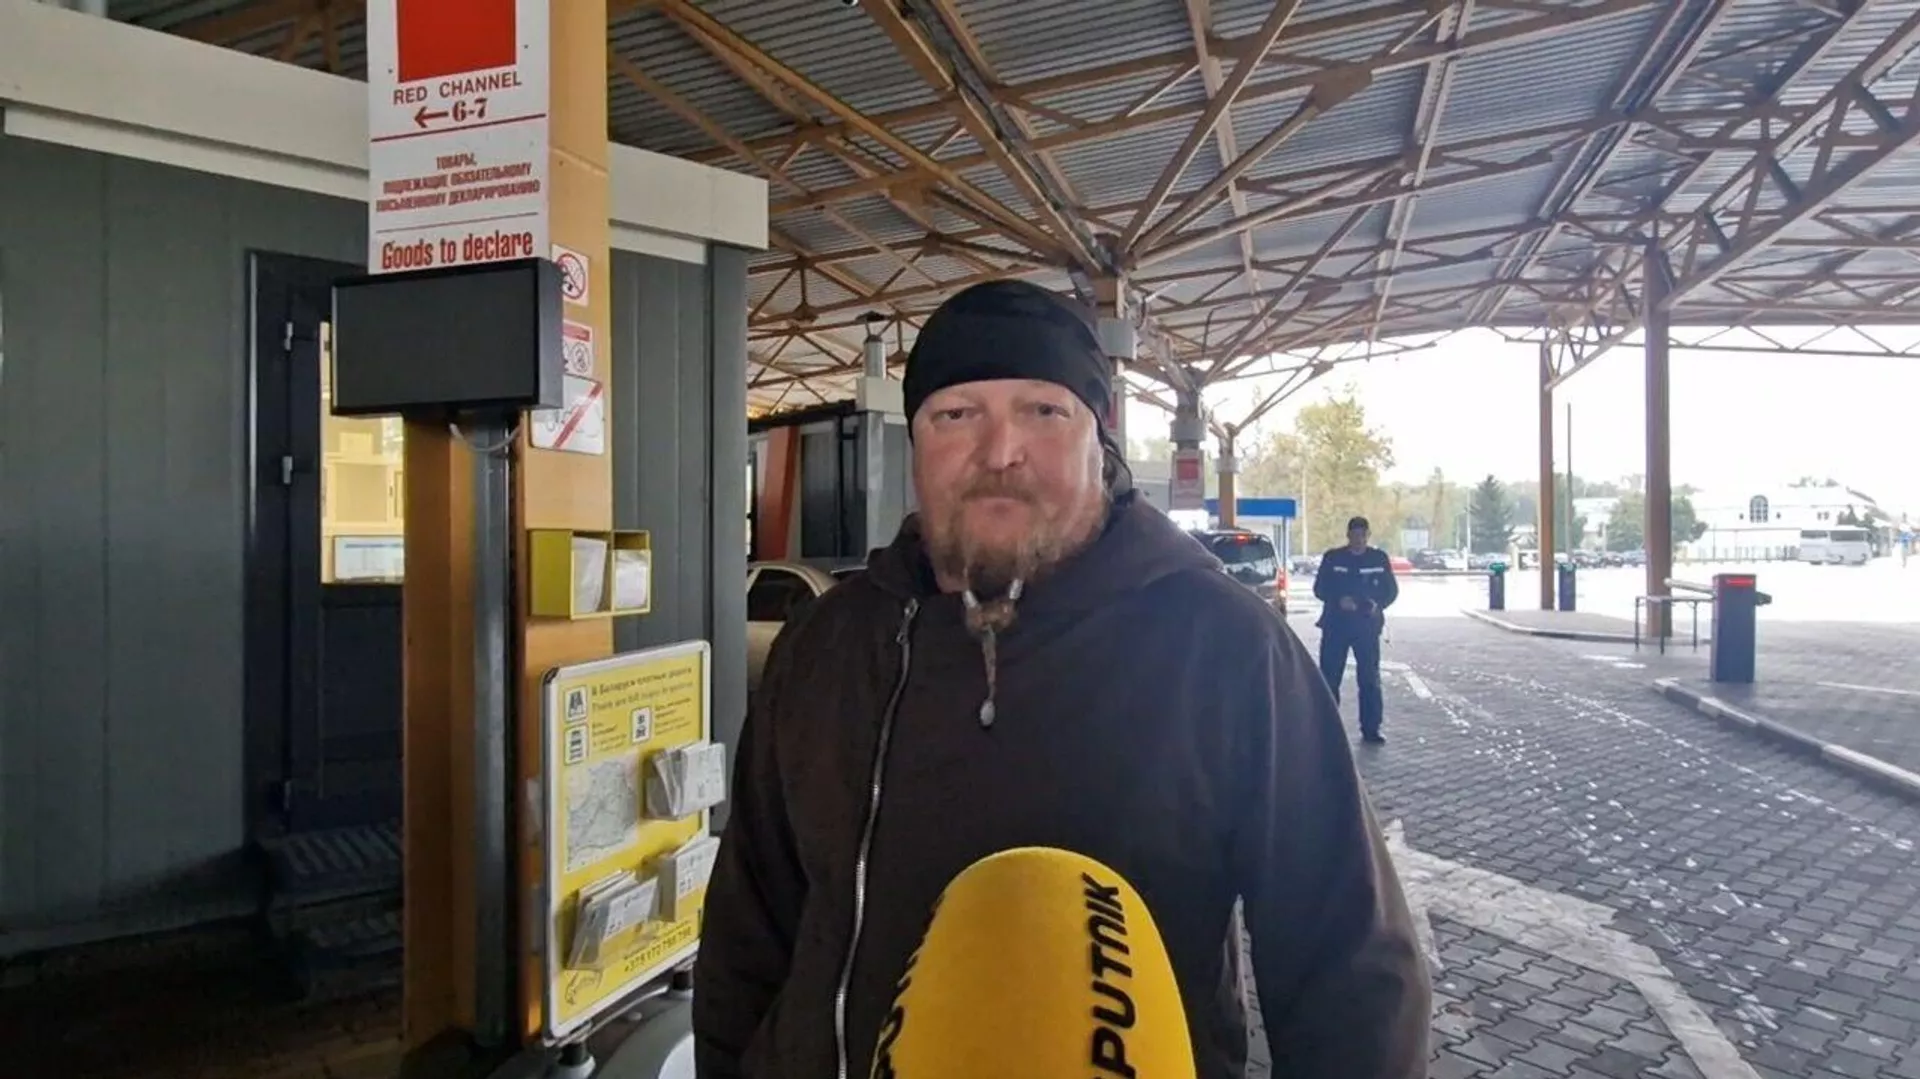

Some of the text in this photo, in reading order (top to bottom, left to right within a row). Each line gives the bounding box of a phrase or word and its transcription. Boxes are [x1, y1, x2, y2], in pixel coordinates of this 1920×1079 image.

[393, 70, 522, 105] RED CHANNEL
[452, 97, 488, 122] 6-7
[451, 162, 532, 185] ОБЯЗАТЕЛЬНОМУ
[448, 179, 541, 206] ДЕКЛАРИРОВАНИЮ
[382, 229, 533, 270] Goods to declare
[1081, 871, 1137, 1079] PUTNIK
